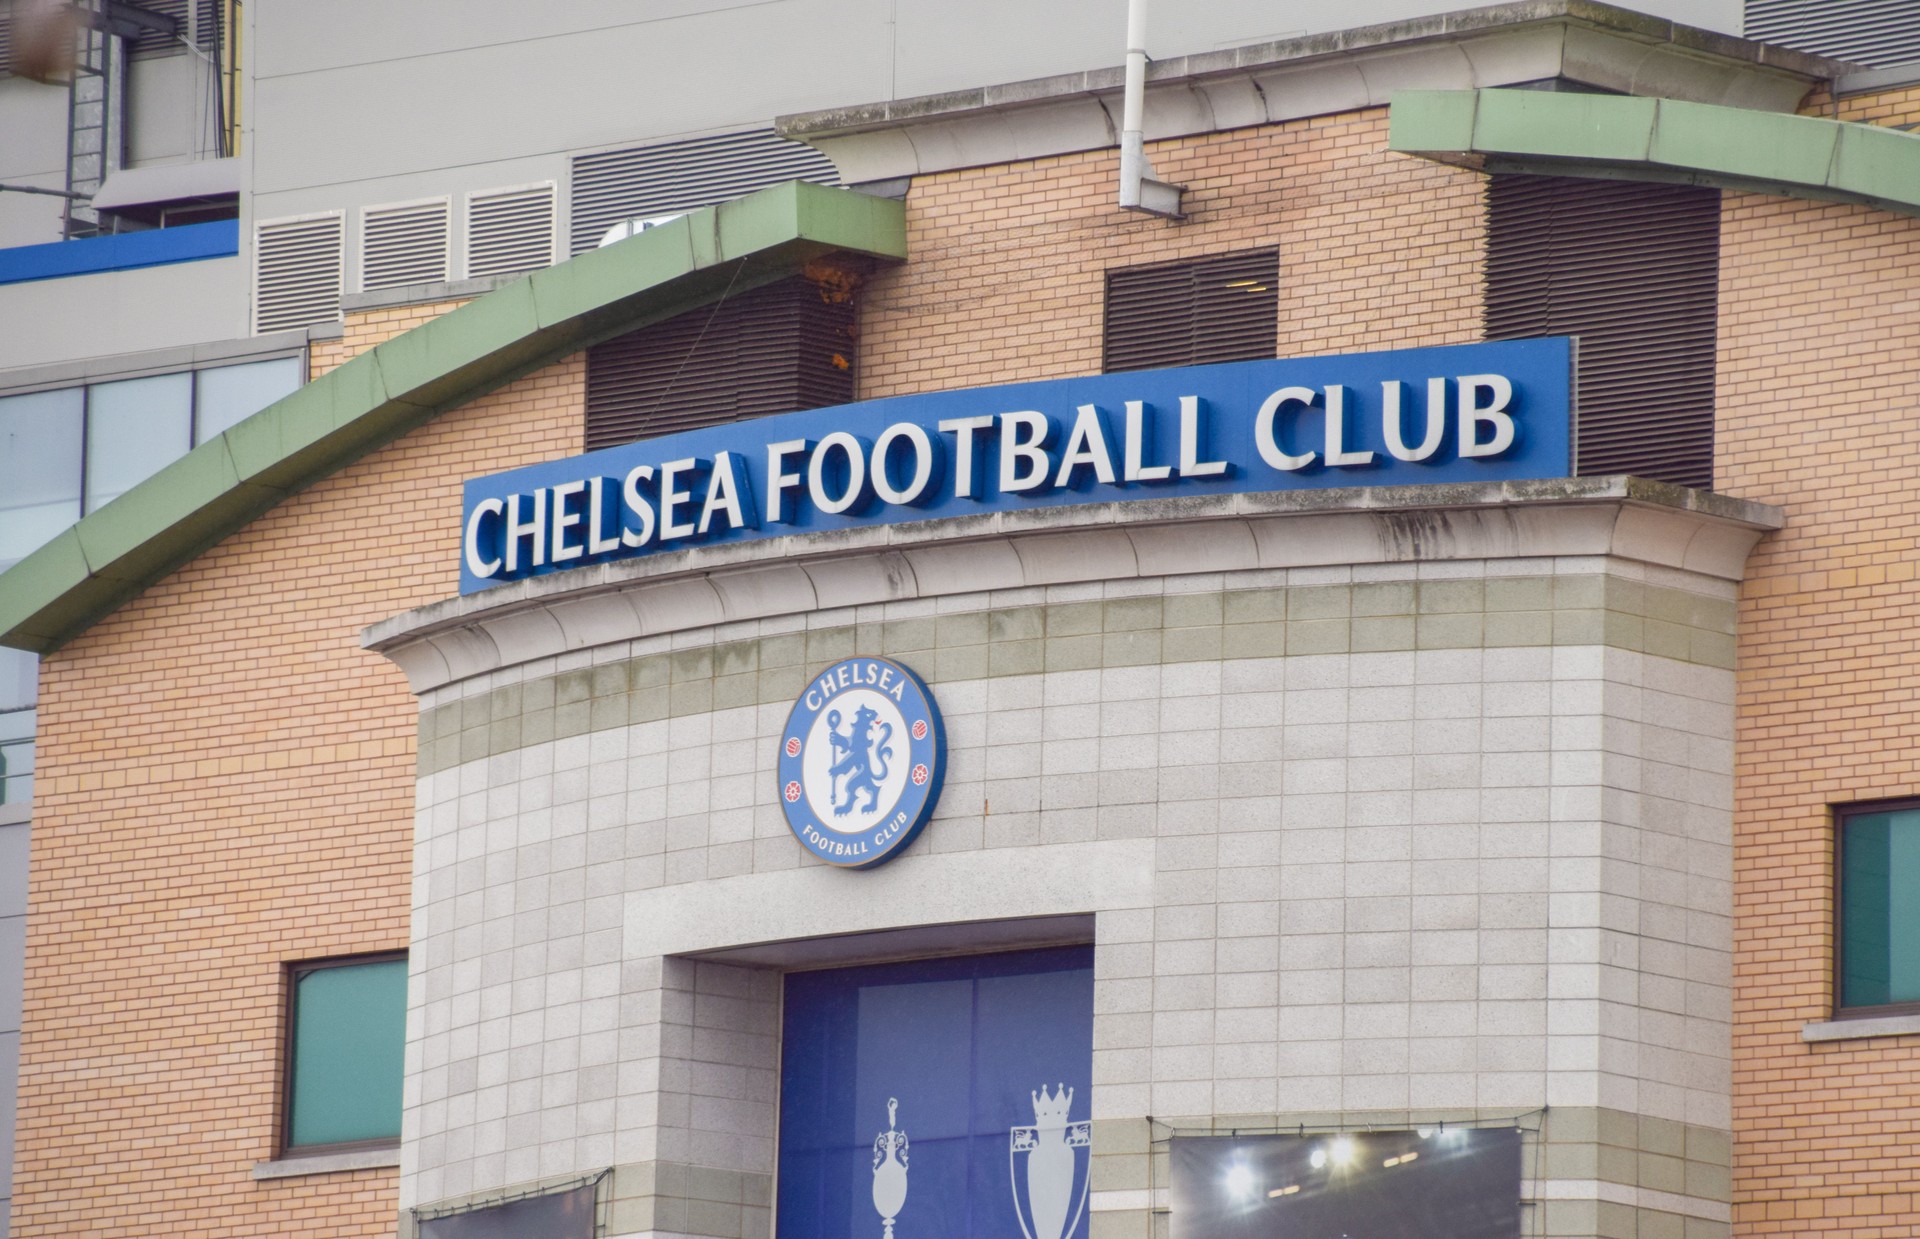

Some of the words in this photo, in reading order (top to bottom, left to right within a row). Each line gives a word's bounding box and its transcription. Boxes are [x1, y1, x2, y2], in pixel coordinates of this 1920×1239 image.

[464, 450, 745, 578] CHELSEA
[766, 394, 1228, 523] FOOTBALL
[1254, 373, 1516, 471] CLUB
[805, 663, 906, 711] CHELSEA
[803, 824, 868, 856] FOOTBALL
[874, 811, 908, 846] CLUB
